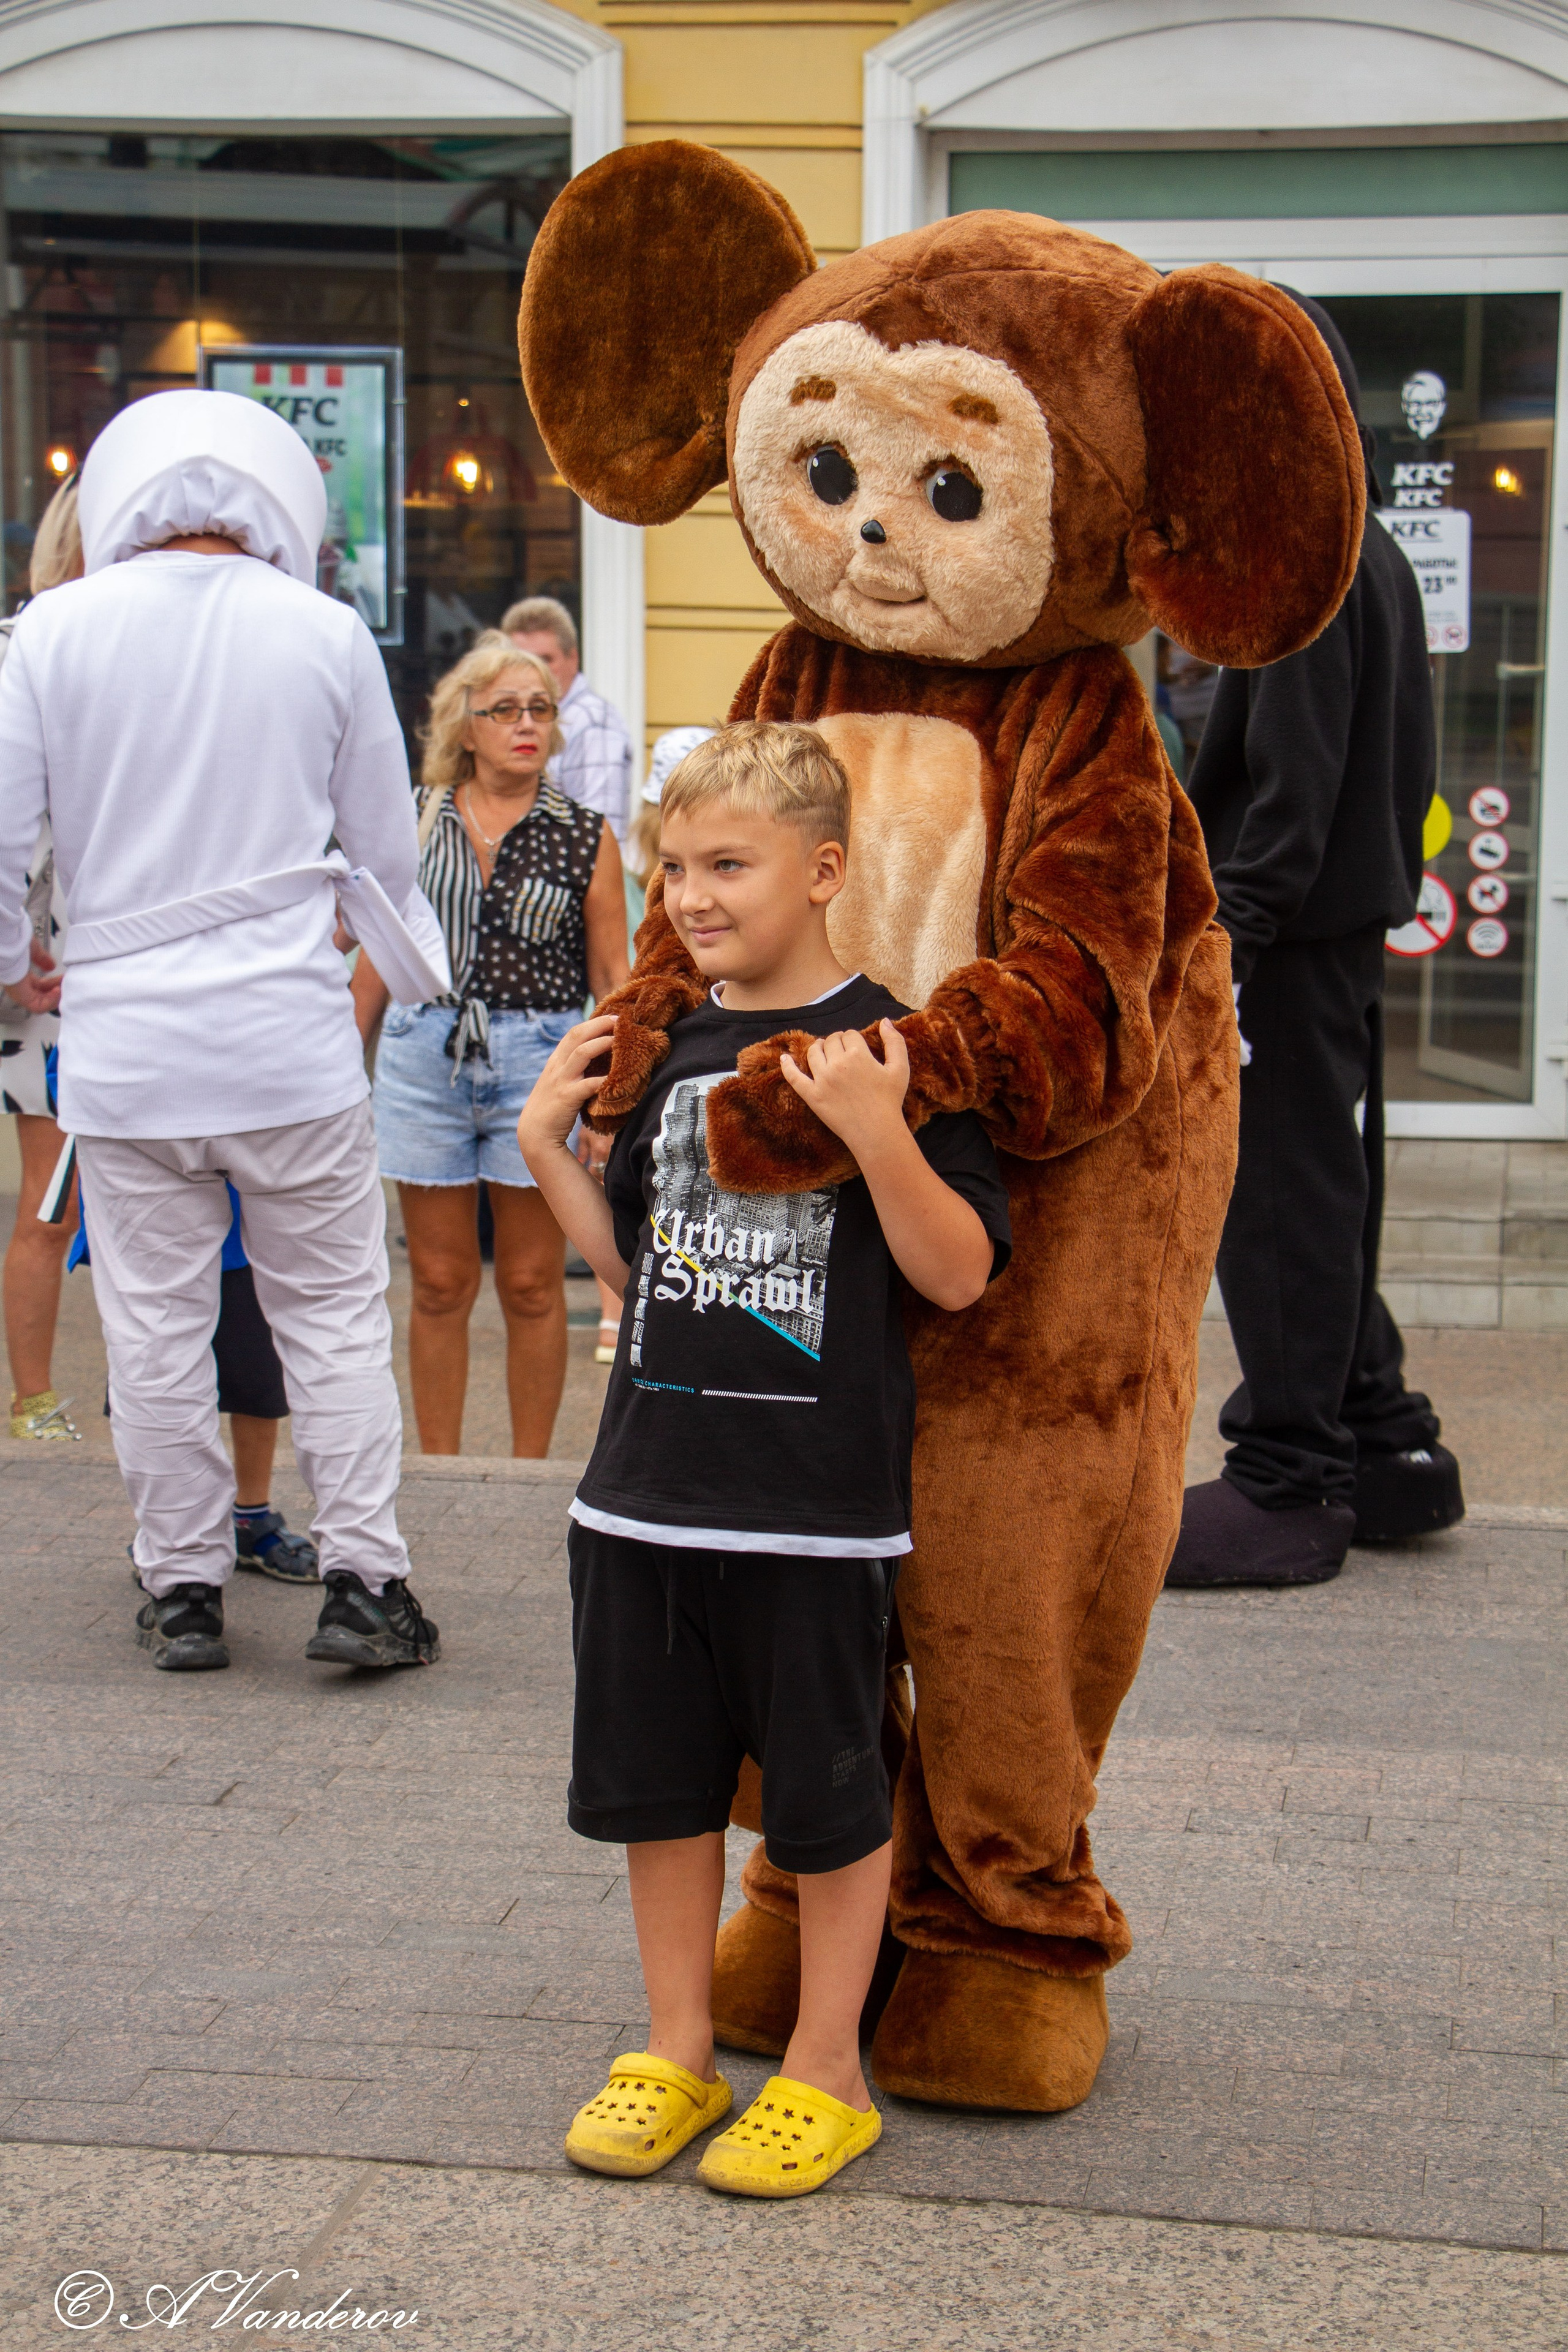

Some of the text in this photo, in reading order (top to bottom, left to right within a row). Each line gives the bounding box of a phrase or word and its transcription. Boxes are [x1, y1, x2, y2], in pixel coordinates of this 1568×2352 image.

[1390, 462, 1455, 486] KFC
[1393, 488, 1443, 507] KFC
[1391, 519, 1441, 537] KFC
[653, 1207, 776, 1264] Urban
[654, 1254, 816, 1313] Sprawl
[644, 1381, 695, 1393] CHARACTERISTICS
